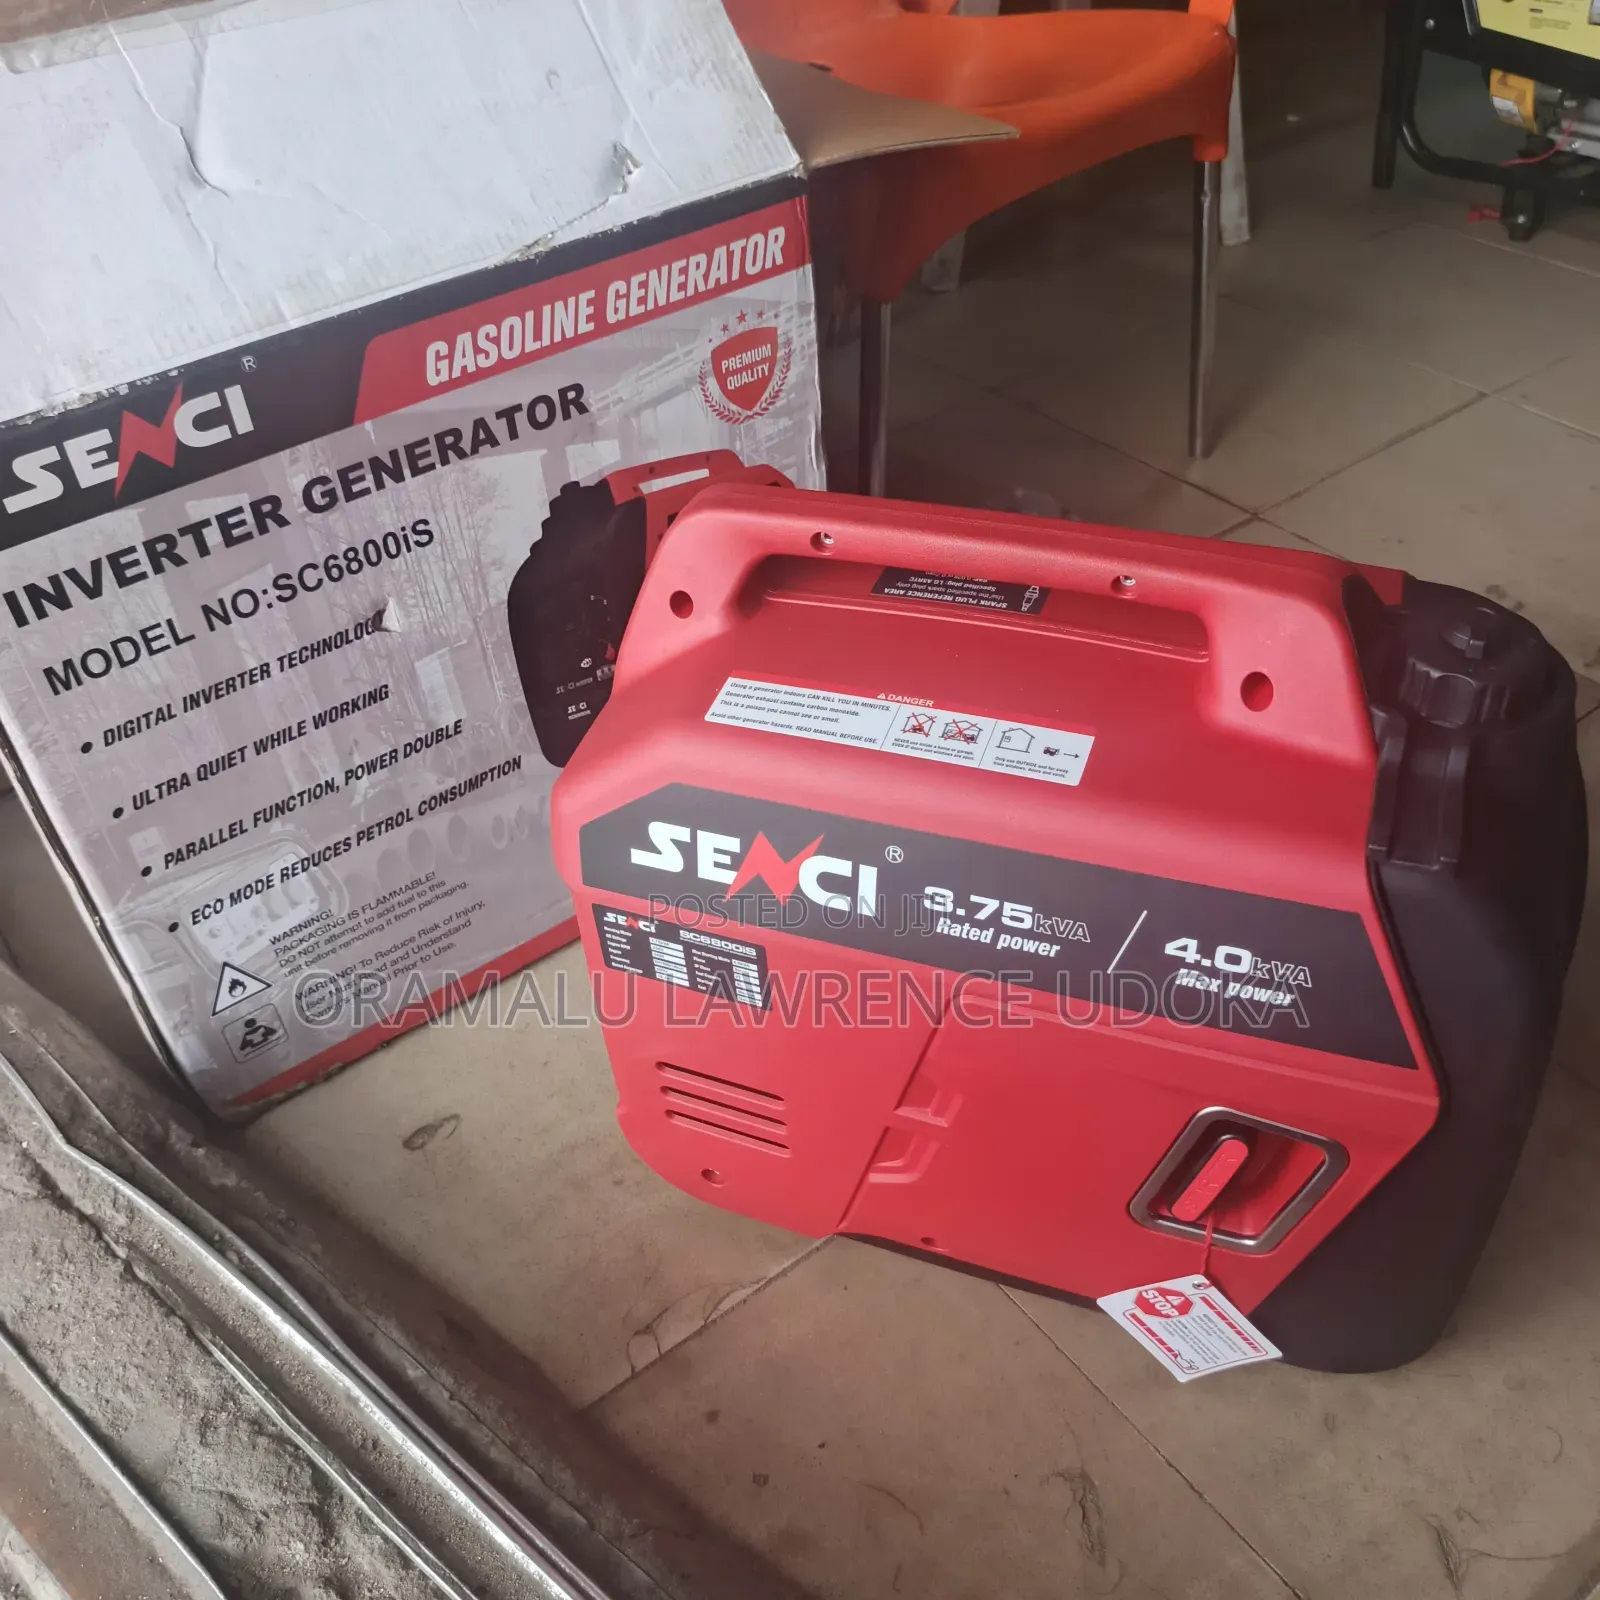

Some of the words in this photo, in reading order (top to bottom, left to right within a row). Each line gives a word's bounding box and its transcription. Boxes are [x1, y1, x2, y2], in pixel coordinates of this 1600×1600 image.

[426, 290, 596, 387] GASOLINE
[605, 226, 786, 324] GENERATOR
[721, 343, 772, 374] PREMIUM
[725, 362, 770, 391] QUALITY
[3, 380, 255, 514] SENCI
[2, 494, 292, 628] INVERTER
[302, 383, 590, 514] GENERATOR
[42, 617, 196, 696] MODEL
[201, 518, 434, 632] NO:SC6800iS
[884, 587, 908, 595] AREA
[908, 589, 954, 602] REFERENCE
[955, 596, 977, 605] PLUG
[978, 599, 1008, 609] SPARK
[103, 703, 177, 748] DIGITAL
[182, 662, 272, 714] INVERTER
[725, 690, 755, 700] Generator
[756, 695, 779, 703] exhaust
[780, 699, 805, 707] contains
[806, 703, 828, 711] carbon
[829, 706, 861, 717] monoxide.
[730, 682, 748, 690] Using
[753, 686, 783, 695] generator
[784, 690, 806, 698] indoors
[807, 693, 821, 701] CAN
[822, 695, 836, 703] KILL
[860, 701, 892, 711] MINUTES.
[745, 704, 766, 712] poison
[779, 709, 800, 717] cannot
[887, 693, 934, 707] DANGER
[710, 711, 726, 719] Avoid
[742, 718, 770, 727] generator
[812, 728, 838, 738] MANUAL
[839, 732, 863, 741] BEFORE
[132, 772, 191, 811] ULTRA
[195, 746, 249, 782] QUIET
[253, 720, 308, 756] WHILE
[312, 684, 390, 730] WORKING
[164, 819, 249, 870] PARALLEL
[253, 778, 340, 828] FUNCTION,
[344, 749, 399, 786] POWER
[403, 719, 463, 760] DOUBLE
[190, 899, 225, 926] ECO
[230, 872, 276, 908] MODE
[280, 837, 352, 883] REDUCES
[356, 808, 414, 847] PETROL
[417, 755, 522, 816] CONSUMPTION
[629, 821, 878, 916] SENCI
[269, 909, 335, 945] WARNING!
[274, 916, 346, 957] PACKAGING
[348, 910, 361, 921] IS
[361, 871, 436, 914] FLAMMABLE!
[279, 953, 298, 968] DO
[298, 941, 321, 961] NOT
[324, 923, 363, 948] attempt
[364, 917, 375, 927] to
[376, 906, 397, 922] add
[397, 895, 416, 912] fuel
[416, 890, 428, 901] to
[429, 880, 447, 896] this
[603, 912, 656, 933] SENCI
[284, 965, 303, 978] unit
[304, 947, 337, 970] before
[339, 925, 385, 954] removing
[385, 918, 394, 929] it
[394, 906, 417, 924] from
[360, 956, 374, 969] To
[375, 936, 418, 963] Reduce
[417, 922, 441, 944] Risk
[442, 915, 455, 927] of
[455, 901, 487, 922] Injury,
[389, 953, 411, 969] and
[411, 918, 473, 961] Understand
[679, 929, 757, 957] SC6800iS
[936, 917, 994, 945] Rated
[996, 930, 1061, 959] power
[394, 960, 419, 978] Prior
[419, 953, 432, 965] to
[433, 942, 457, 958] Use.
[1175, 967, 1222, 993] Max
[1224, 979, 1298, 1008] power
[1141, 1289, 1180, 1317] STOP
